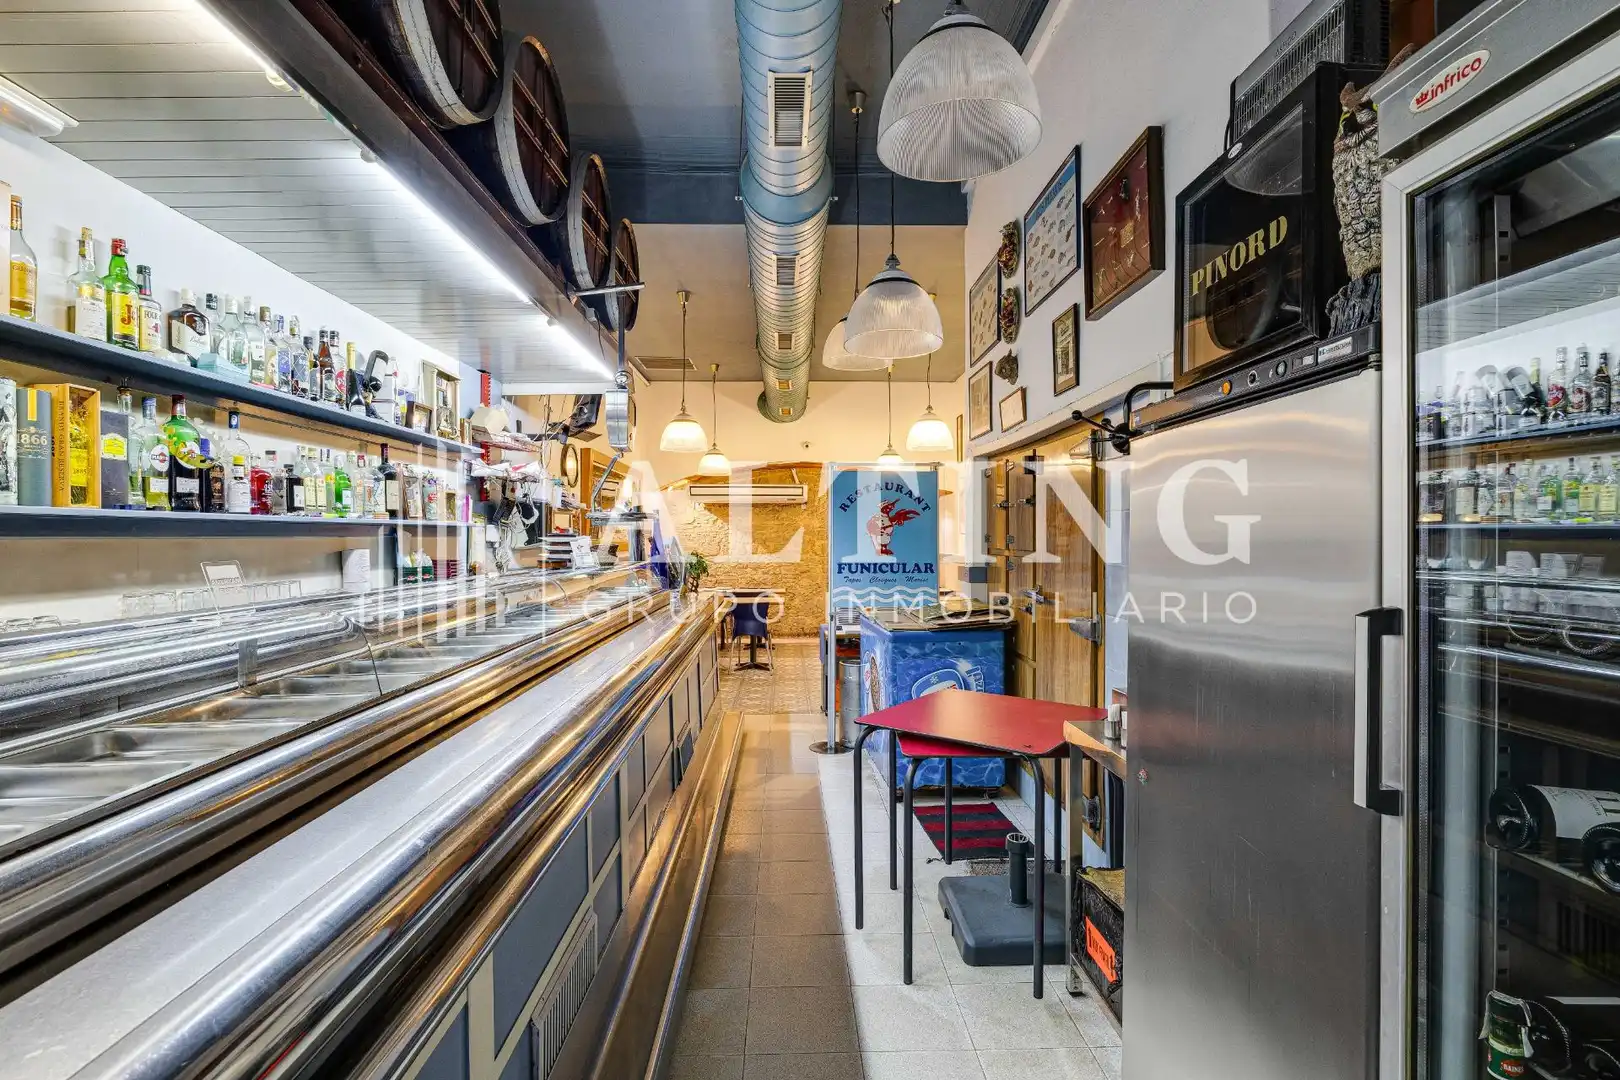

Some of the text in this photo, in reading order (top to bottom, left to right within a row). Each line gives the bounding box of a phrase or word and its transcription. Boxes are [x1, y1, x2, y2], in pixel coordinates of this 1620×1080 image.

[1429, 57, 1482, 101] infrico
[1190, 215, 1288, 297] PINORD
[839, 481, 931, 513] RESTAURANT
[836, 561, 936, 575] FUNICULAR
